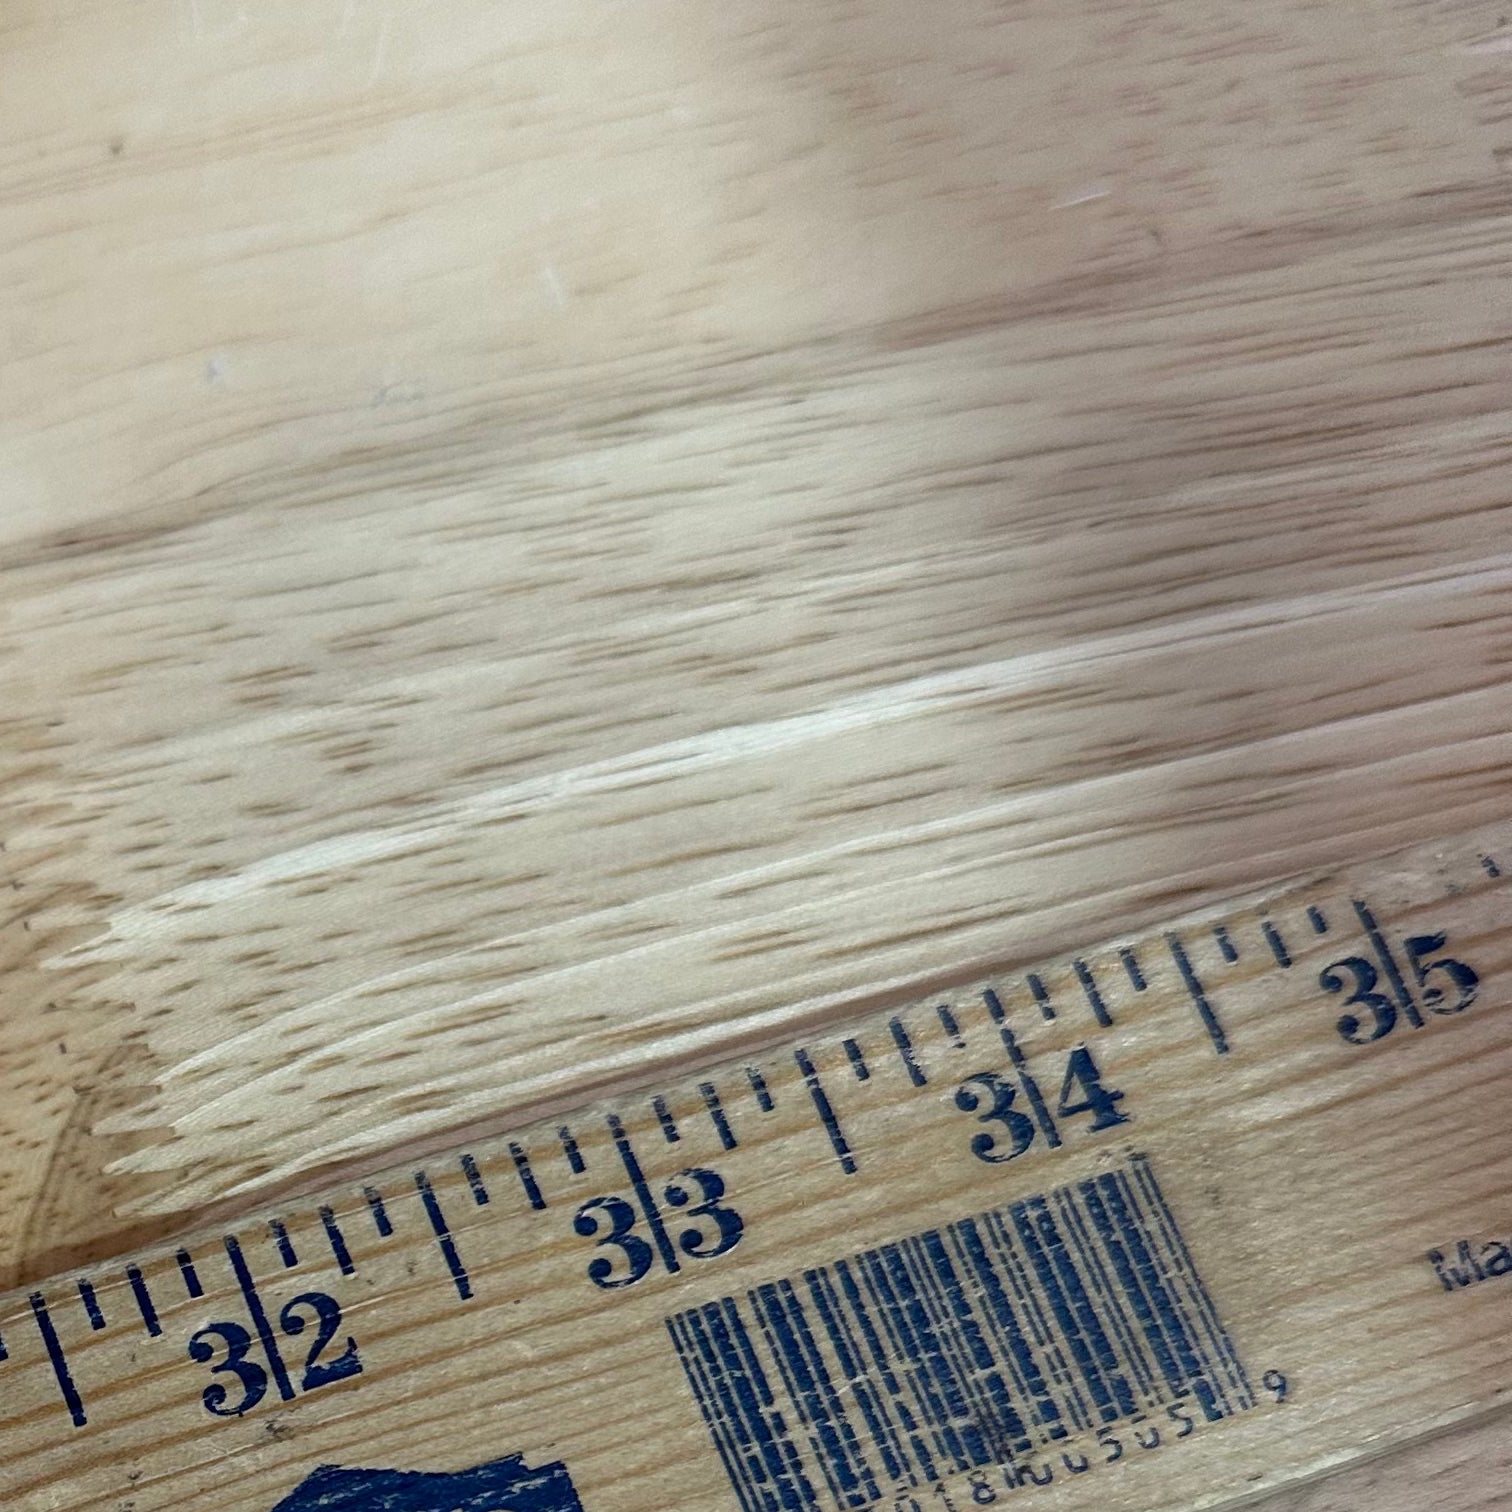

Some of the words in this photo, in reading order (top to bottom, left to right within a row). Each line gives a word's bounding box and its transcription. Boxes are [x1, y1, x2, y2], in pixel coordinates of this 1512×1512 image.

[189, 1292, 363, 1417] 32
[573, 1167, 744, 1289] 33
[955, 1042, 1130, 1163] 34
[1319, 930, 1479, 1044] 35
